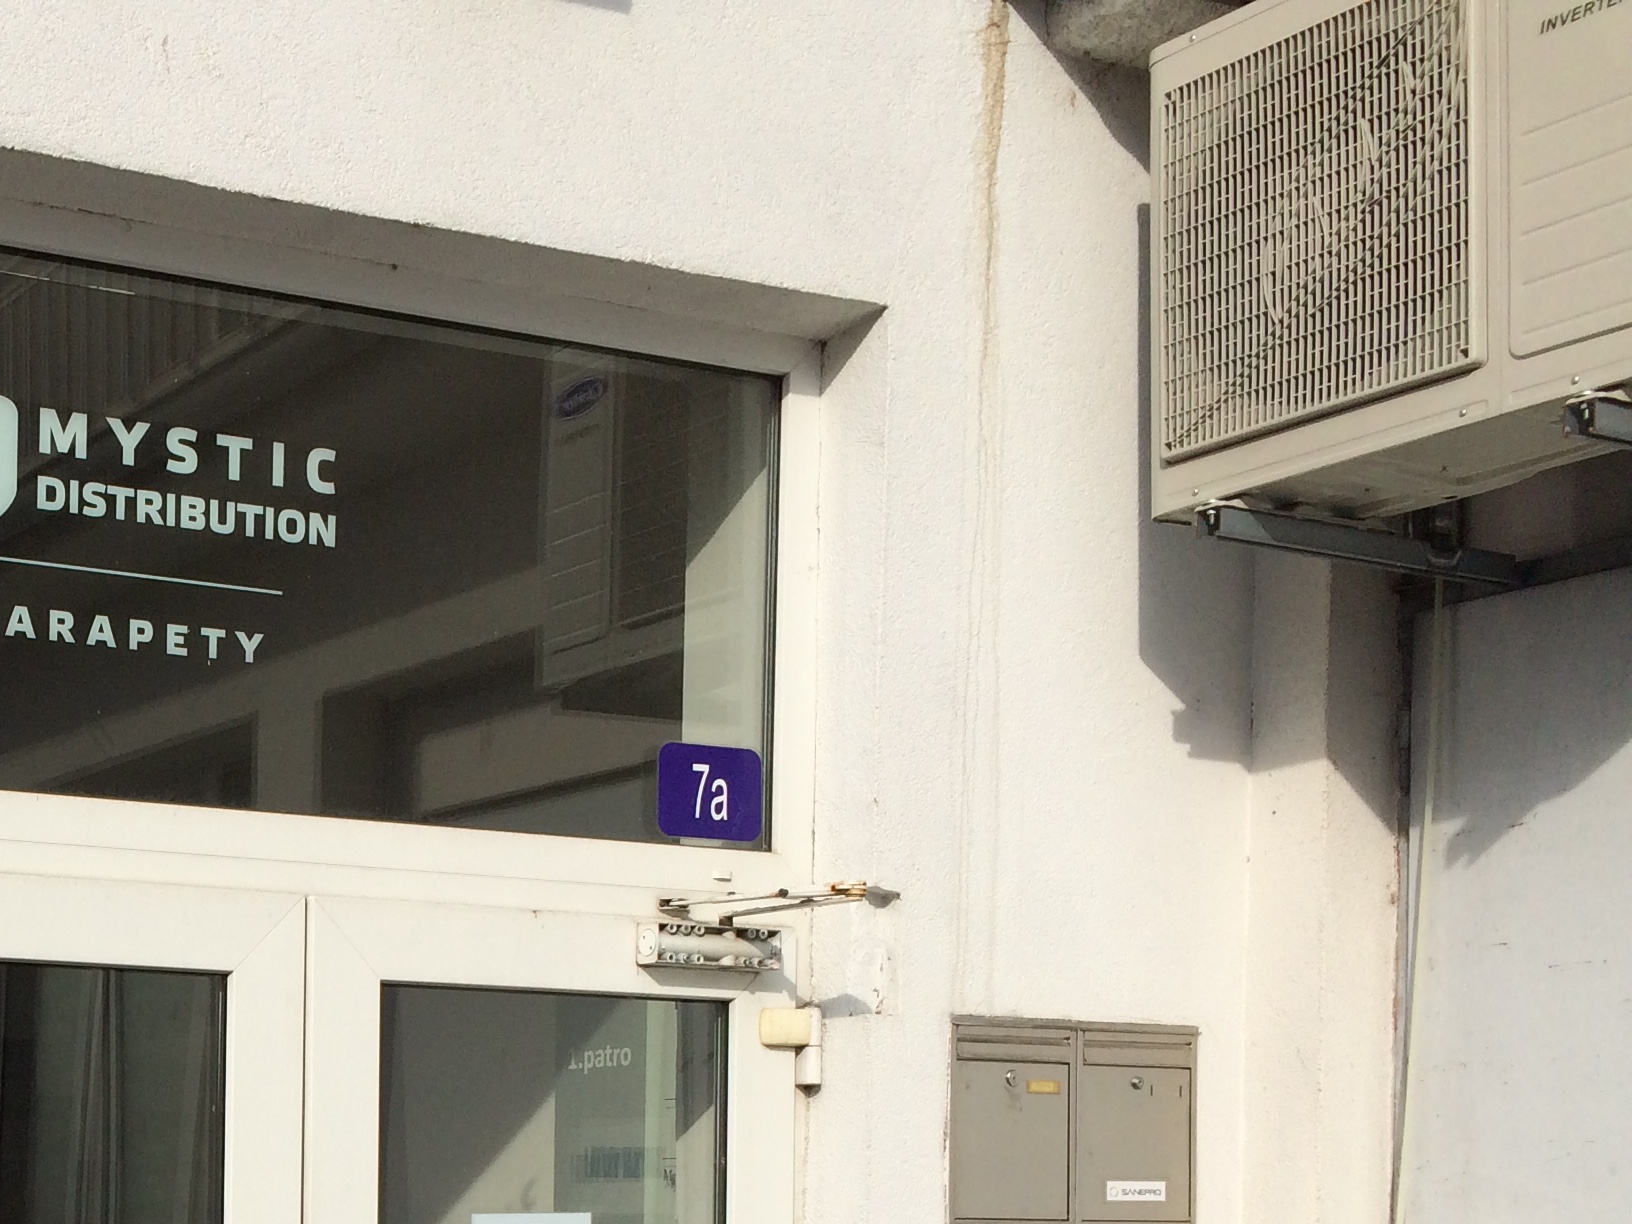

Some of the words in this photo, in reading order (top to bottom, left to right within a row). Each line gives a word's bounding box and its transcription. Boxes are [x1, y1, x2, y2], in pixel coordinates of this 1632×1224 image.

[38, 407, 337, 495] MYSTIC
[36, 475, 337, 548] DISTRIBUTION
[692, 763, 729, 821] 7a
[568, 1045, 632, 1075] 1.patro
